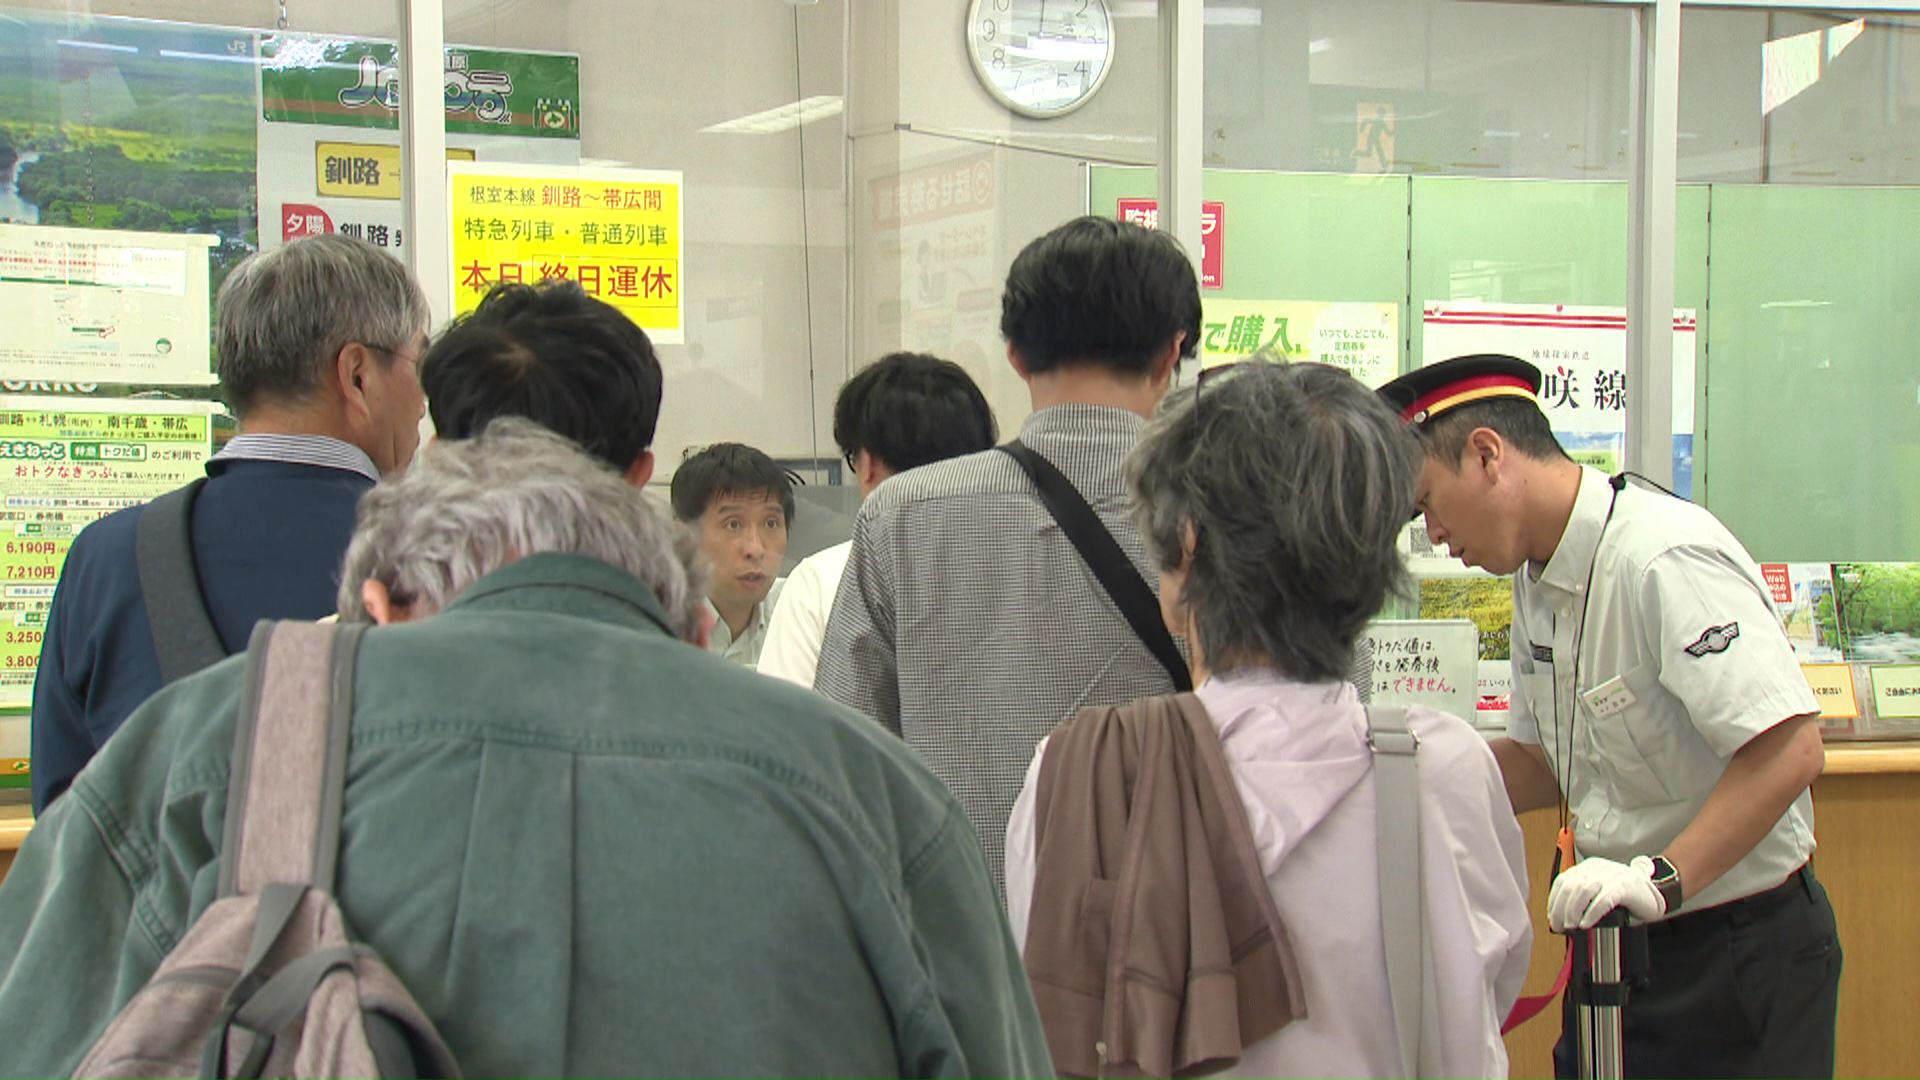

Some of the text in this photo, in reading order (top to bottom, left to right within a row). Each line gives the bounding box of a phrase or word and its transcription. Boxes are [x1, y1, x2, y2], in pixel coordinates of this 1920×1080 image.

[982, 19, 996, 42] 9
[227, 40, 247, 52] JR
[992, 48, 1006, 70] 8
[1074, 60, 1089, 77] 4
[325, 156, 381, 187] 釧路
[470, 185, 536, 205] 根室本線
[286, 214, 325, 235] 夕陽
[464, 217, 668, 247] 特急列車・普通列車
[6, 542, 56, 554] 6,190円
[7, 566, 56, 579] 7,210円
